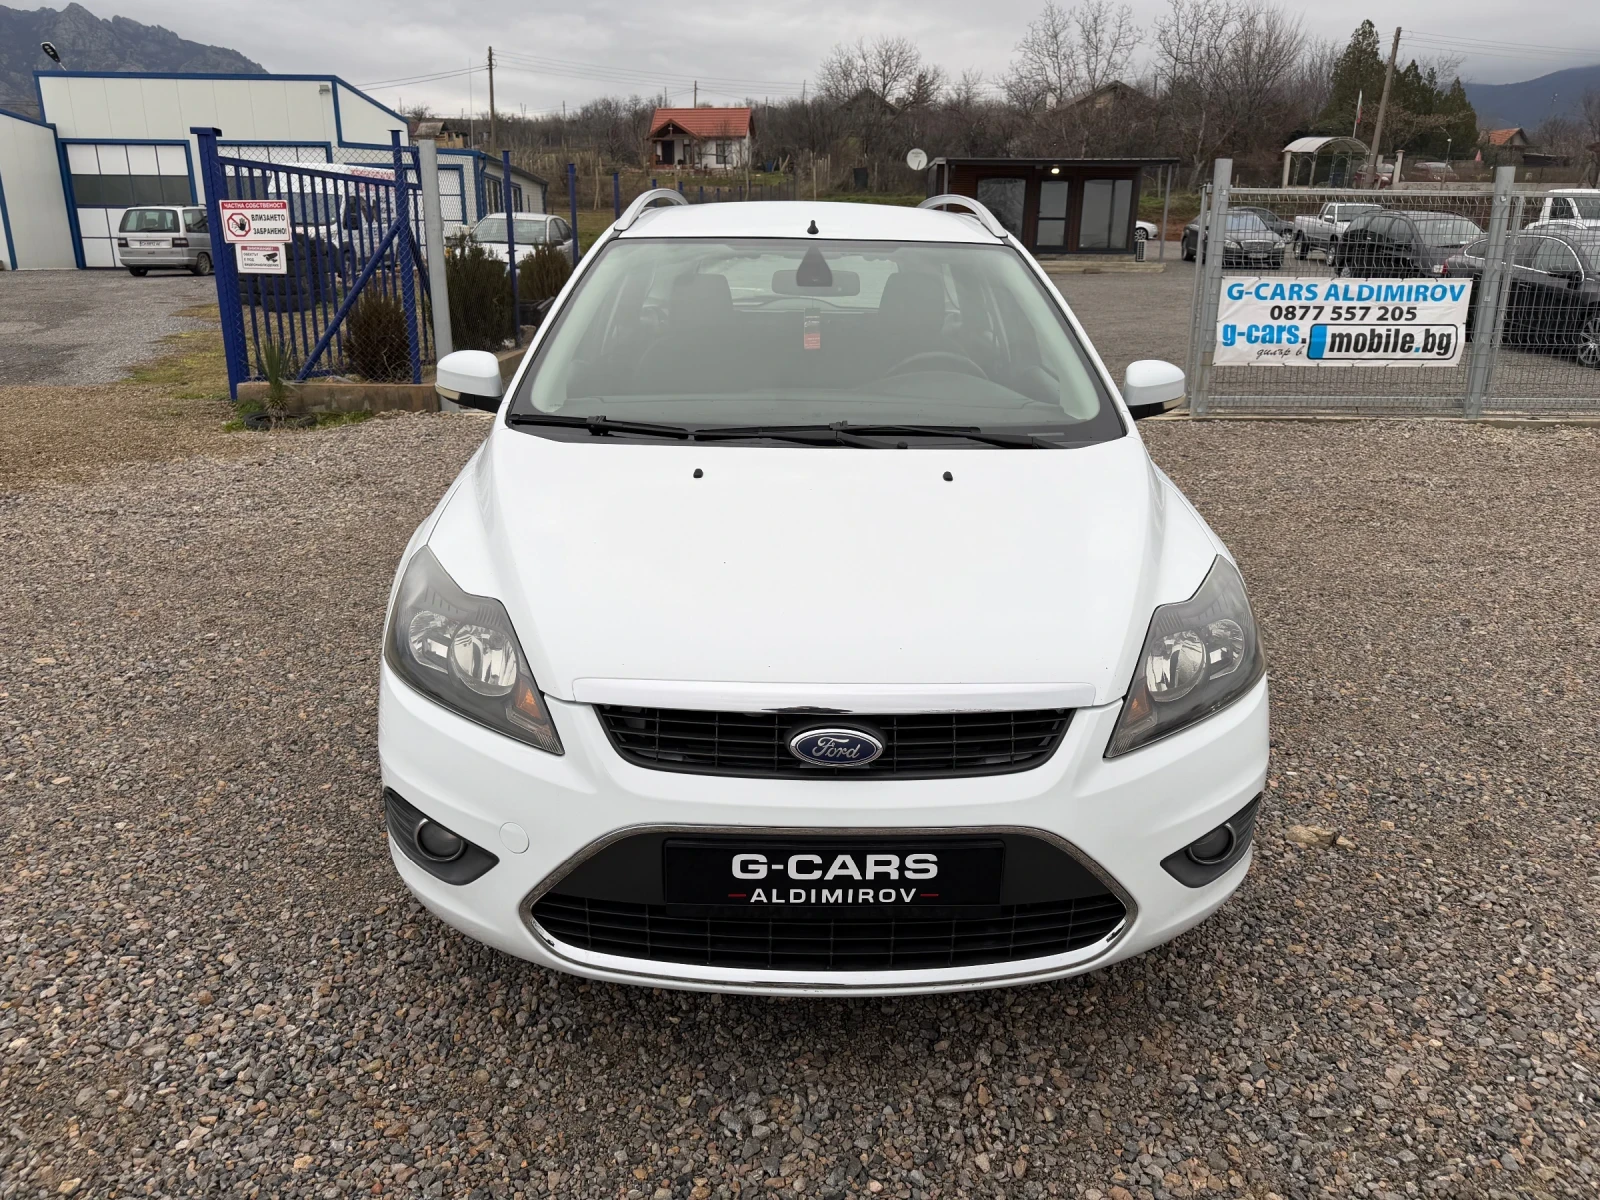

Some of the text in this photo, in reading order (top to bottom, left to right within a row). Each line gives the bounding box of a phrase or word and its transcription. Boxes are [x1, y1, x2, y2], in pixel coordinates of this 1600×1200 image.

[1227, 282, 1467, 302] G-CARS ALDIMIROV
[1270, 305, 1418, 321] 0877 557 205
[1328, 328, 1452, 356] mobile.bg
[811, 736, 861, 759] Ford
[731, 853, 939, 880] G-CARS
[749, 888, 917, 903] ALDIMIROV
